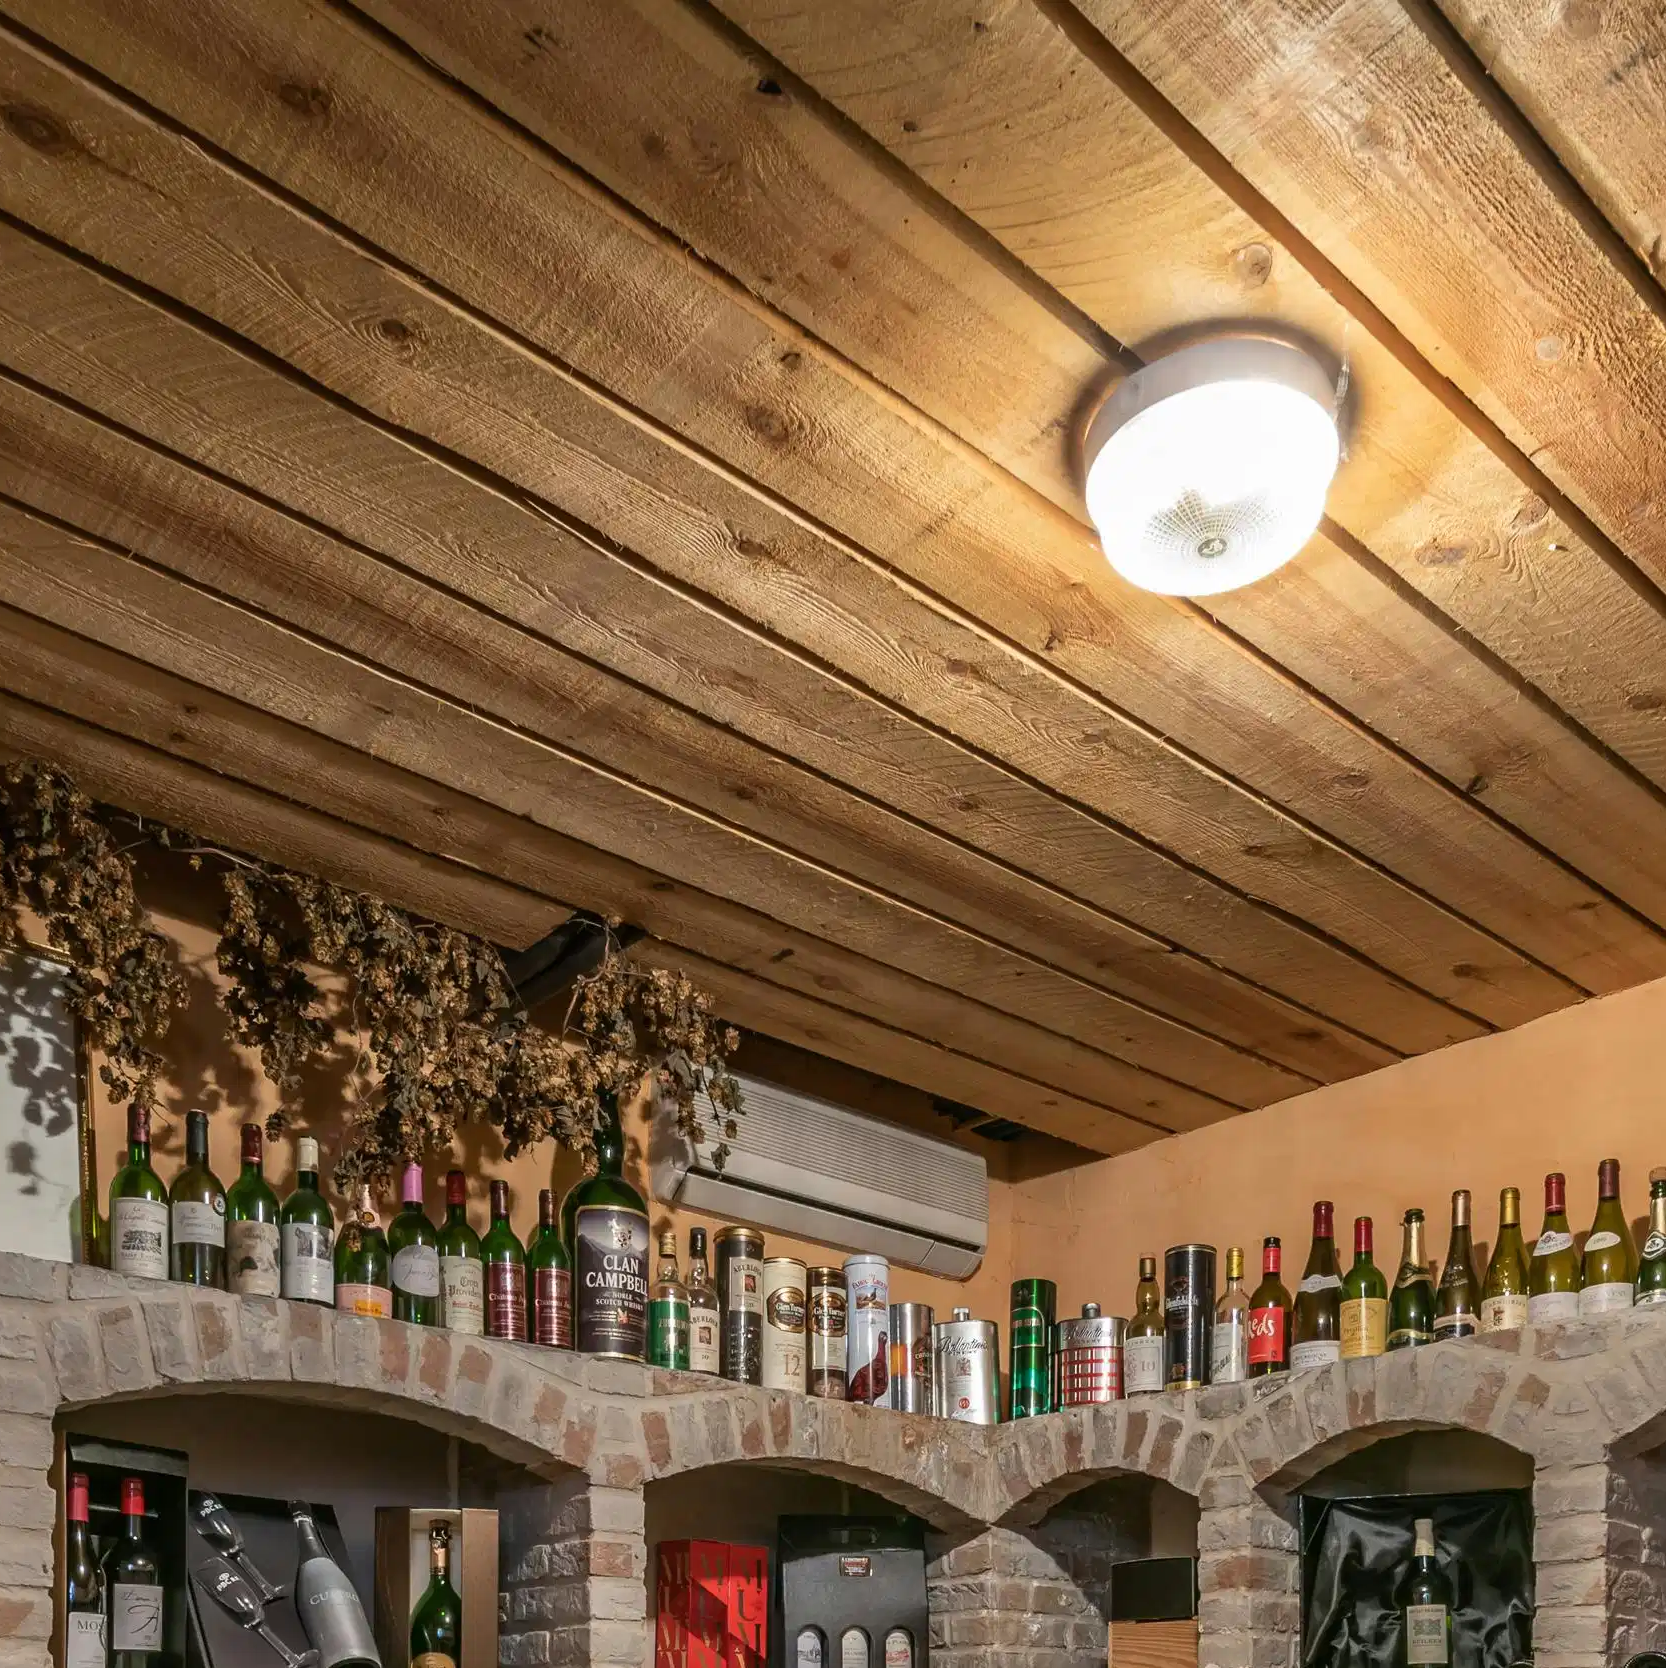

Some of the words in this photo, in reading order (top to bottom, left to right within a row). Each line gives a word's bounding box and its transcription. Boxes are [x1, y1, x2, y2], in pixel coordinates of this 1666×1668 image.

[603, 1253, 639, 1274] CLAN
[586, 1271, 649, 1297] CAMPBELL
[782, 1352, 801, 1377] 12
